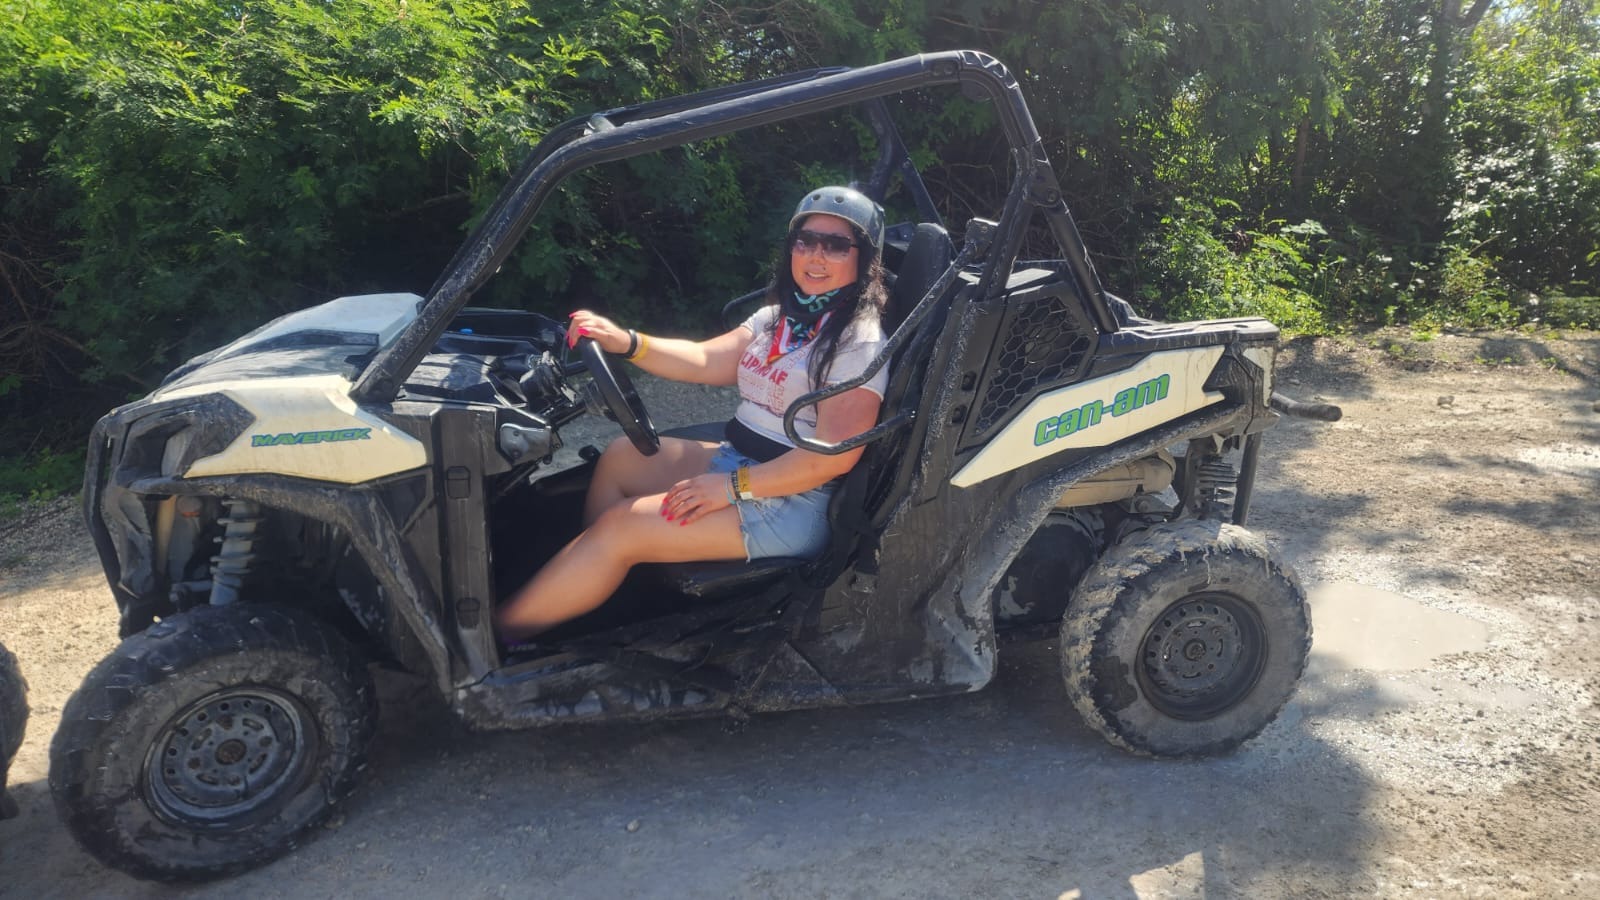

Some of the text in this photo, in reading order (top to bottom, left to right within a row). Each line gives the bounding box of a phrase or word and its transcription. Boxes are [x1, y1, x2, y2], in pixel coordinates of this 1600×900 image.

[768, 368, 788, 385] AF
[1034, 373, 1170, 446] can-am
[251, 428, 372, 447] MAVERICK
